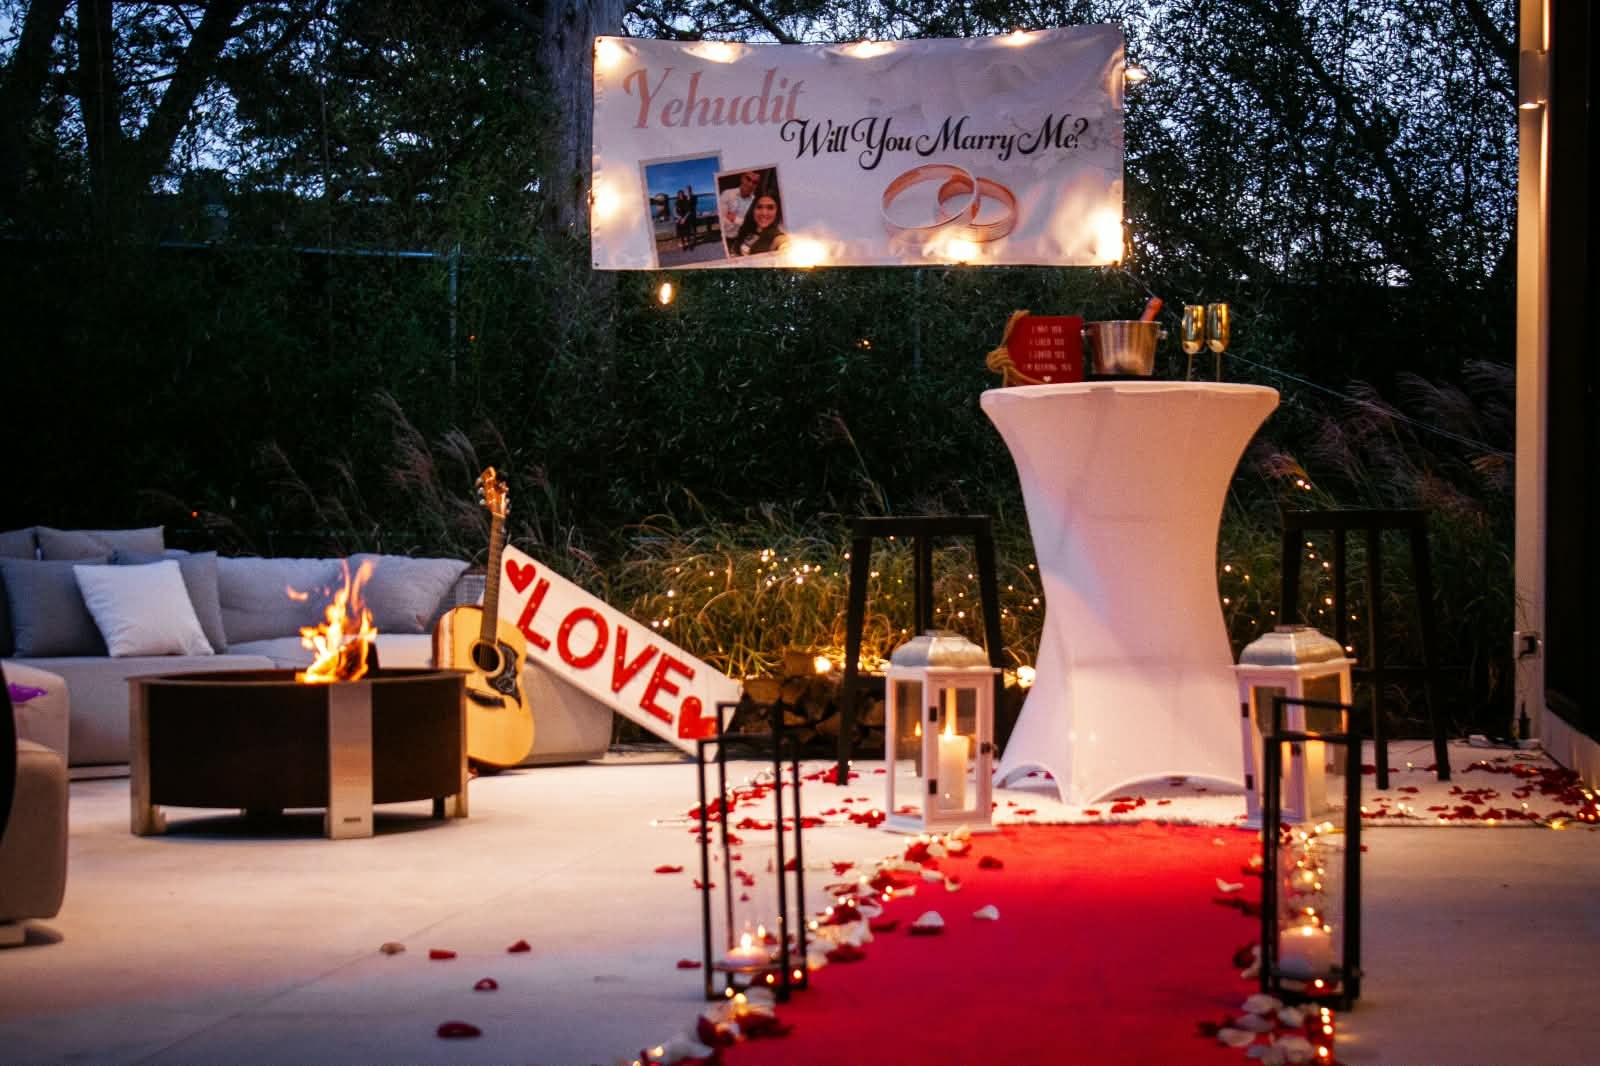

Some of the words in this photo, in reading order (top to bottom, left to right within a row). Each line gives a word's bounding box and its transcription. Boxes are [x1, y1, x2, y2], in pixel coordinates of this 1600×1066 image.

[623, 66, 806, 129] Yehudit
[780, 118, 849, 160] Will
[851, 116, 913, 170] You
[915, 115, 1015, 161] Marry
[1016, 113, 1089, 155] Me?
[516, 577, 696, 725] LOVE
